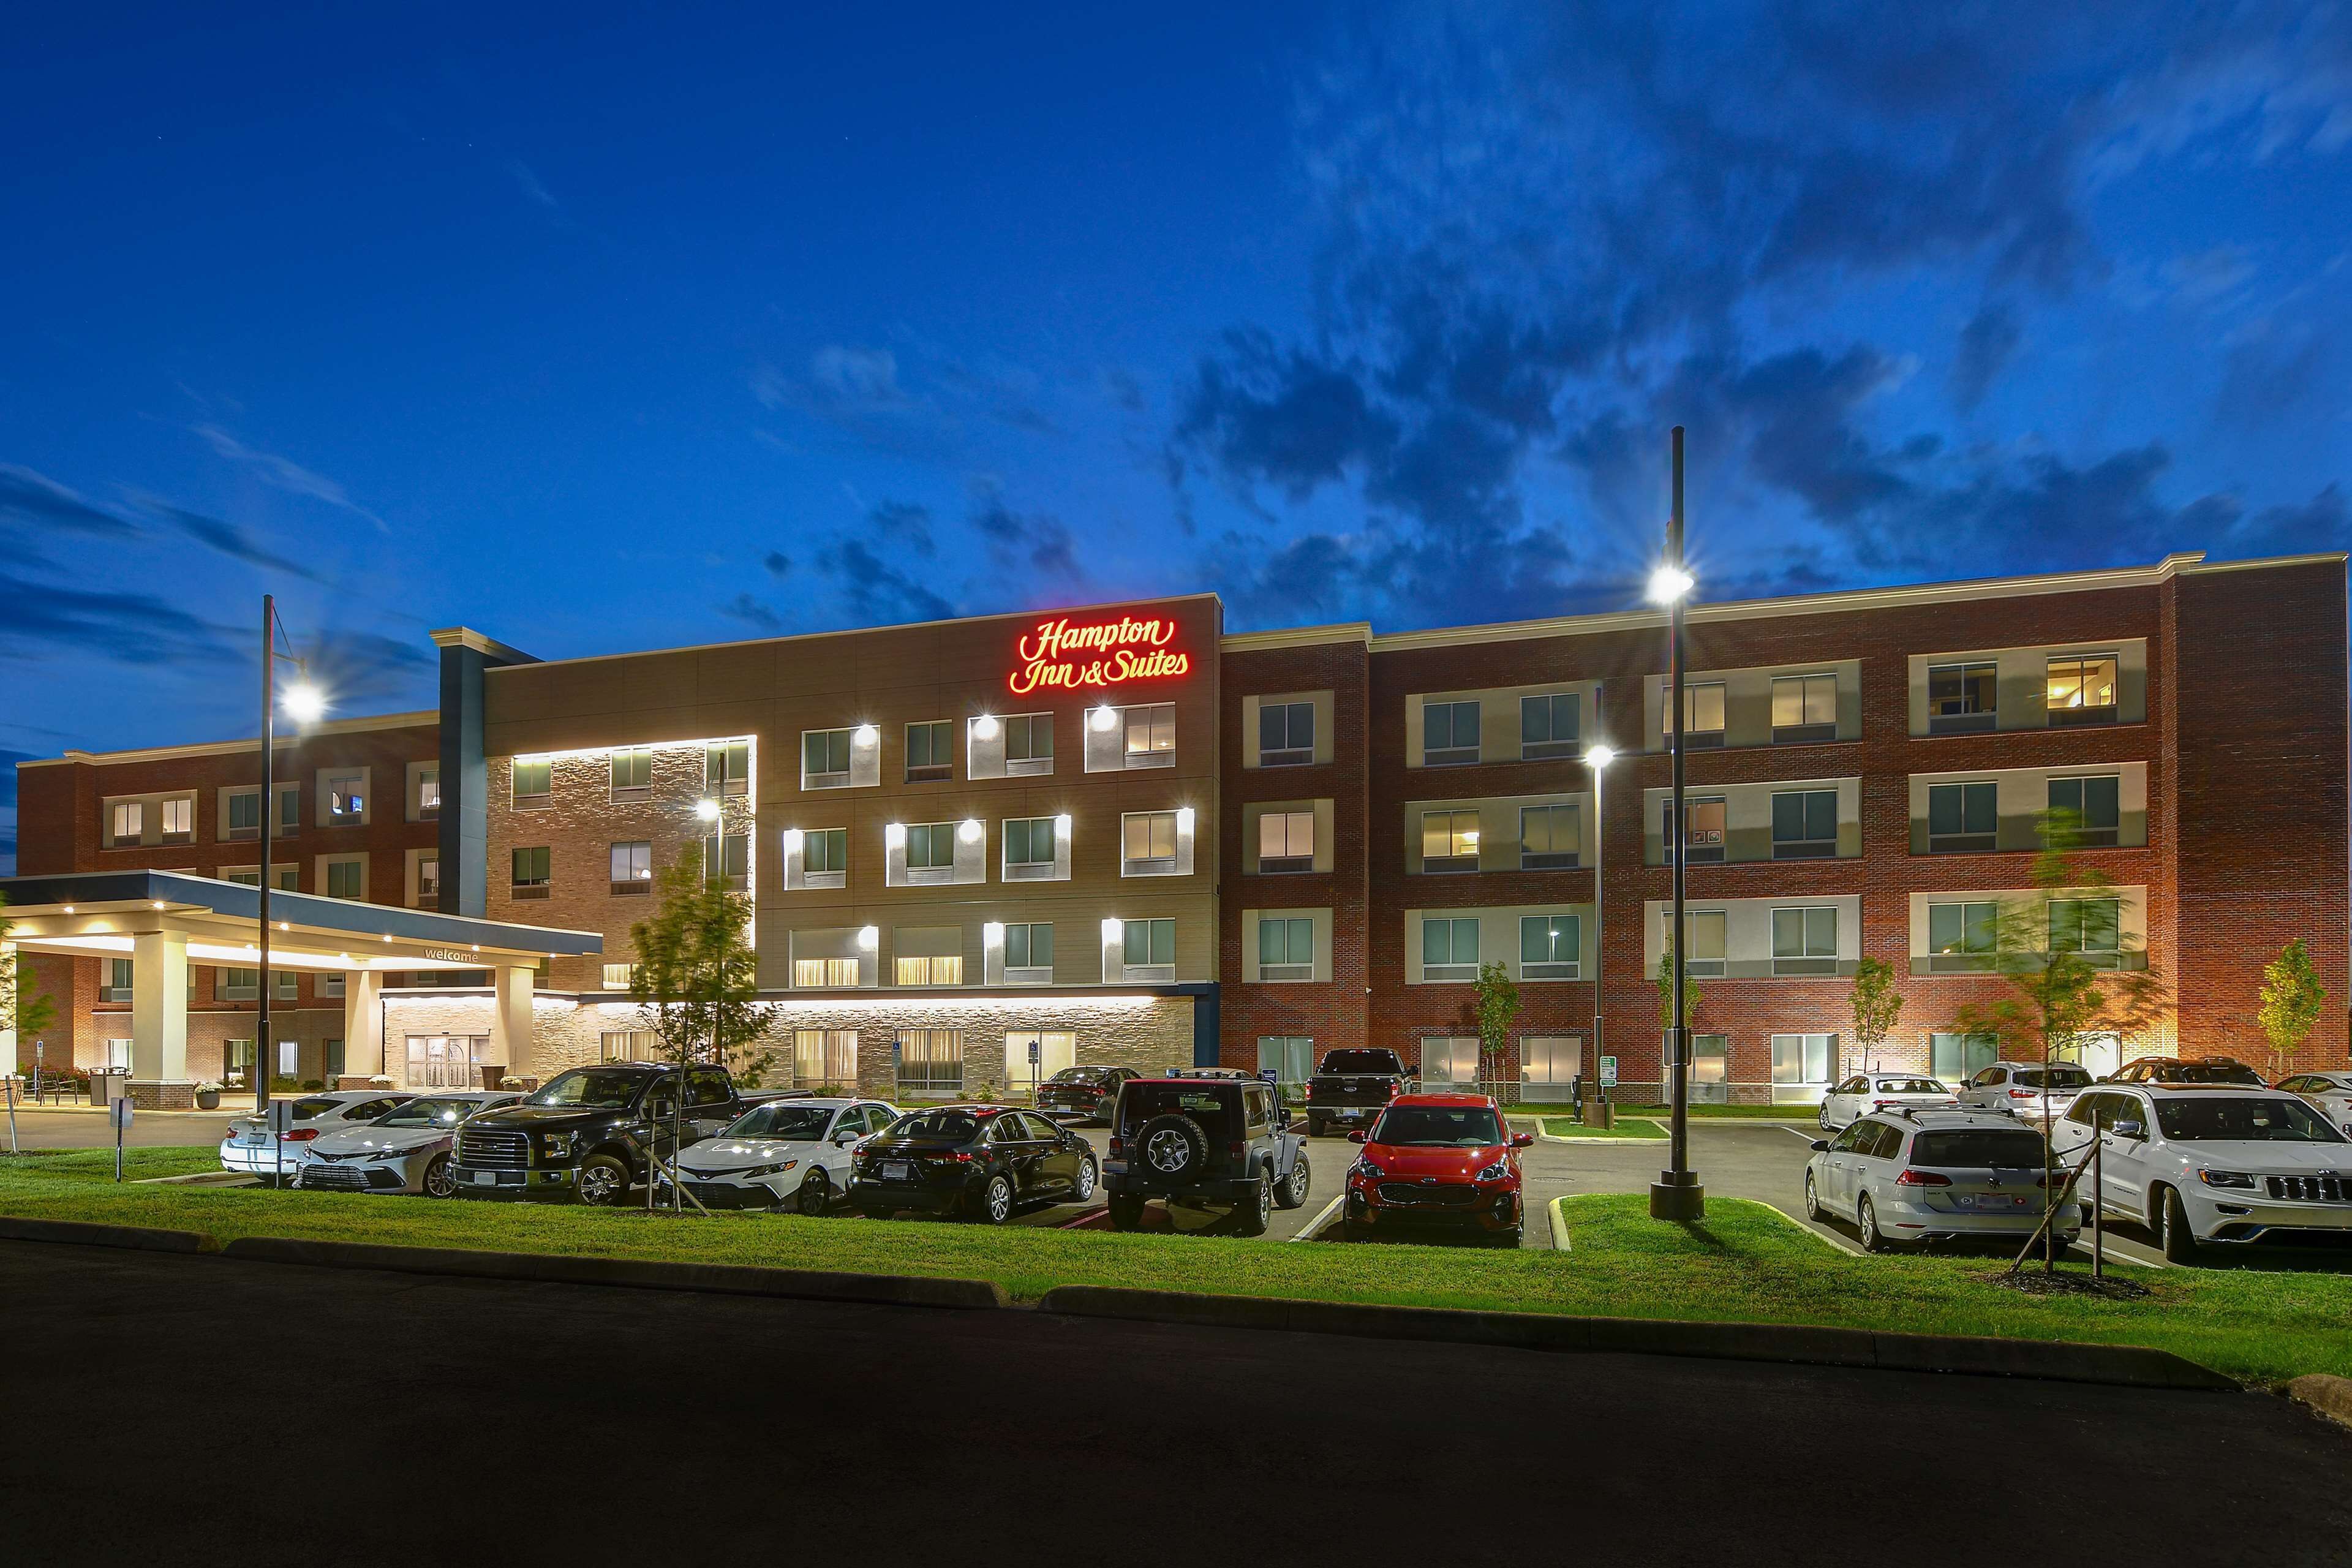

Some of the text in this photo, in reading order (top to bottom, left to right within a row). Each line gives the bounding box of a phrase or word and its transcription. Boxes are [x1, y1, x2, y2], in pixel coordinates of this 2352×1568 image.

[1019, 617, 1174, 662] Hampton
[1010, 649, 1188, 693] Inn & Suites
[425, 948, 478, 962] welcome
